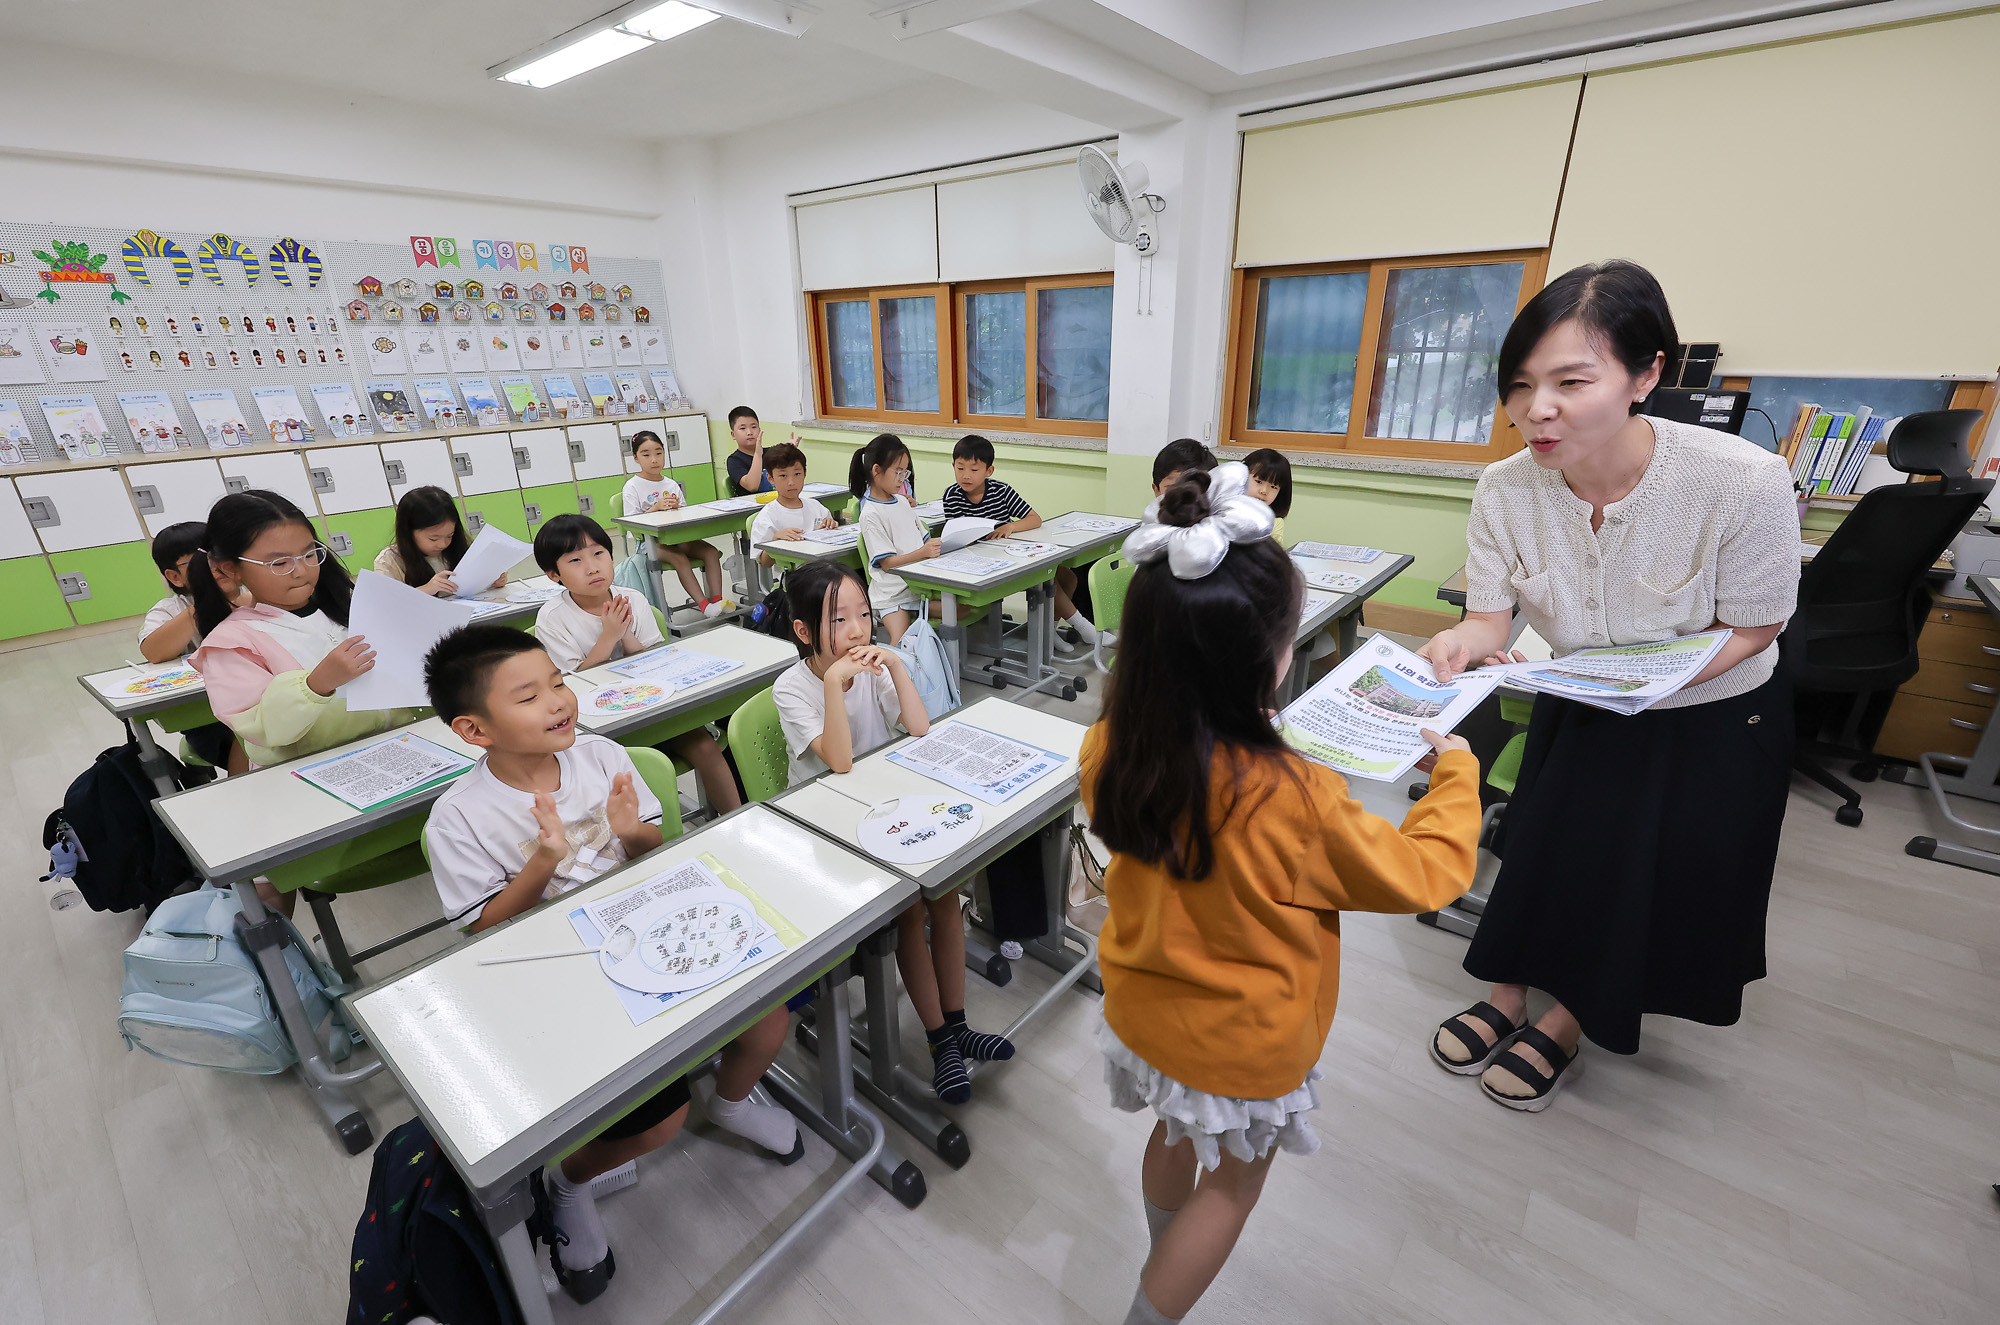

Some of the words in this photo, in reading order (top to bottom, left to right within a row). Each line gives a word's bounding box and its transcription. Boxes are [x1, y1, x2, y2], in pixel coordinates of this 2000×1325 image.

[417, 239, 453, 257] 꿈을
[479, 245, 535, 260] 키우는
[1394, 662, 1417, 678] 나의
[1029, 762, 1048, 776] 매일
[1012, 771, 1031, 785] 운동
[994, 782, 1015, 795] 기록
